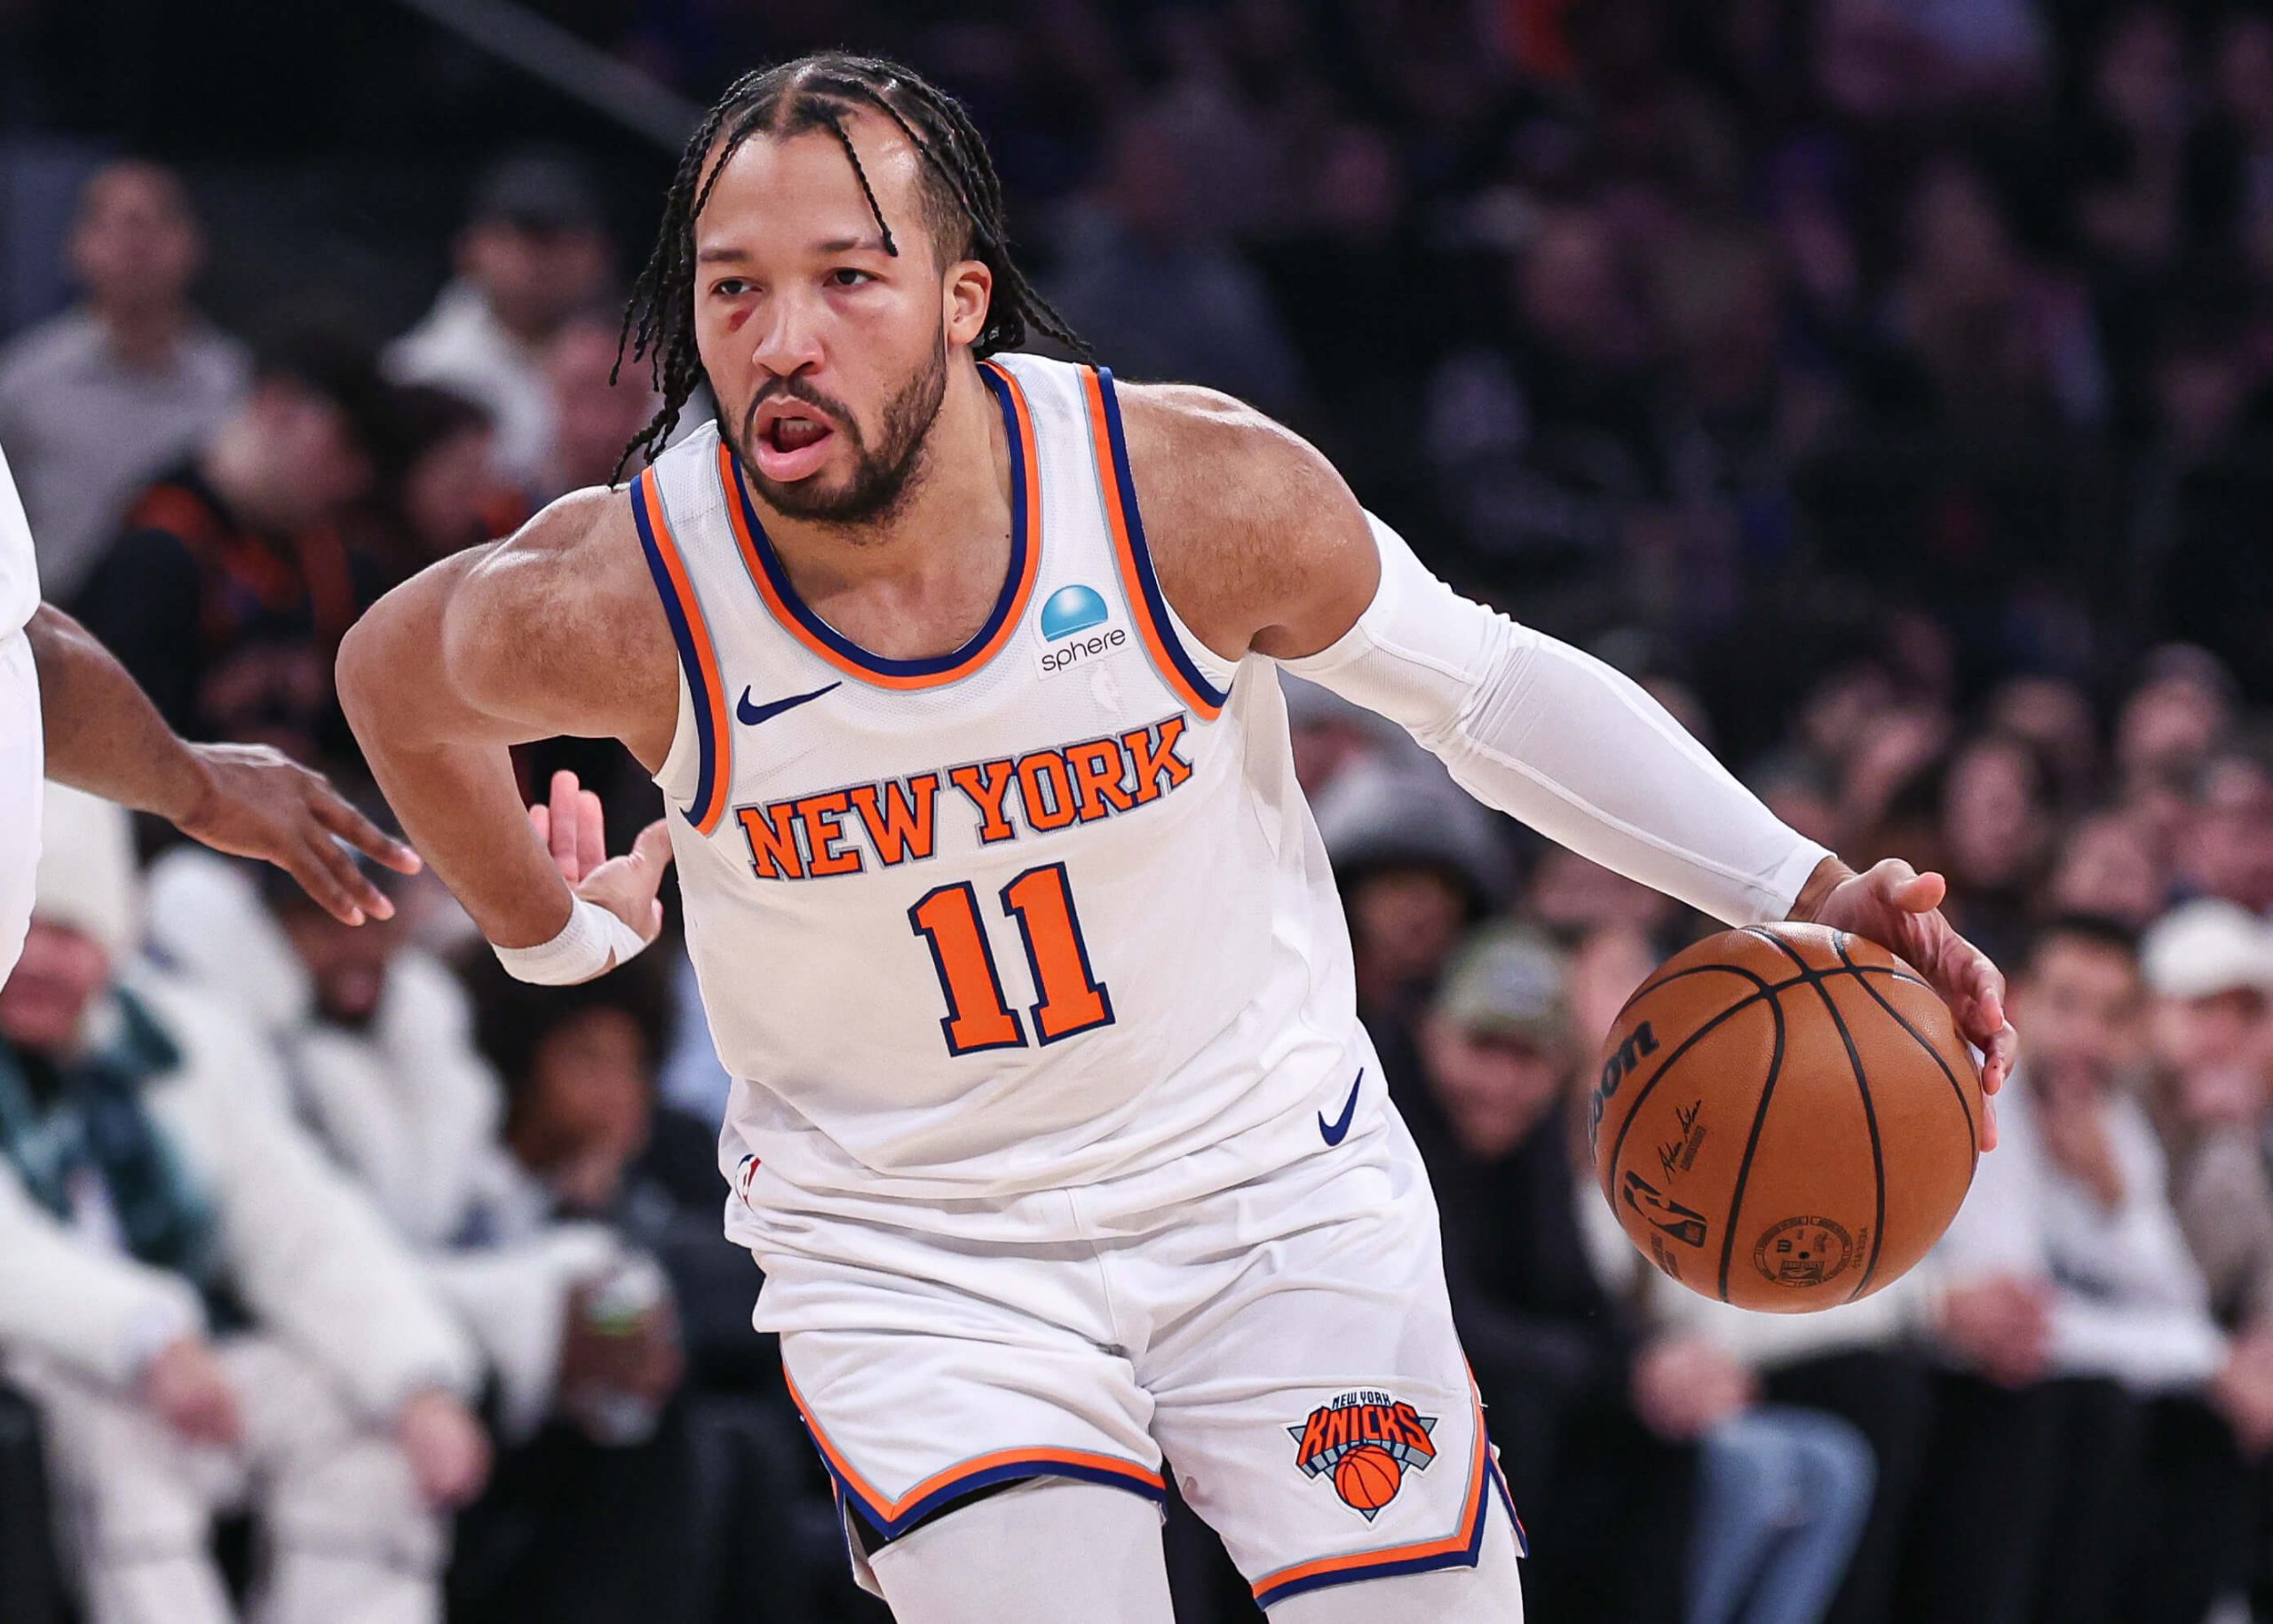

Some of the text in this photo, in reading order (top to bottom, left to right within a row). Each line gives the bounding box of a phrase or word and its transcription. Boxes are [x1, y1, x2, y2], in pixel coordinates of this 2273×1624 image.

[1041, 629, 1126, 671] sphere
[733, 711, 1194, 880] NEW YORK
[907, 861, 1115, 1058] 11
[1295, 1400, 1437, 1468] KNICKS
[1332, 1390, 1391, 1410] NEW YORK
